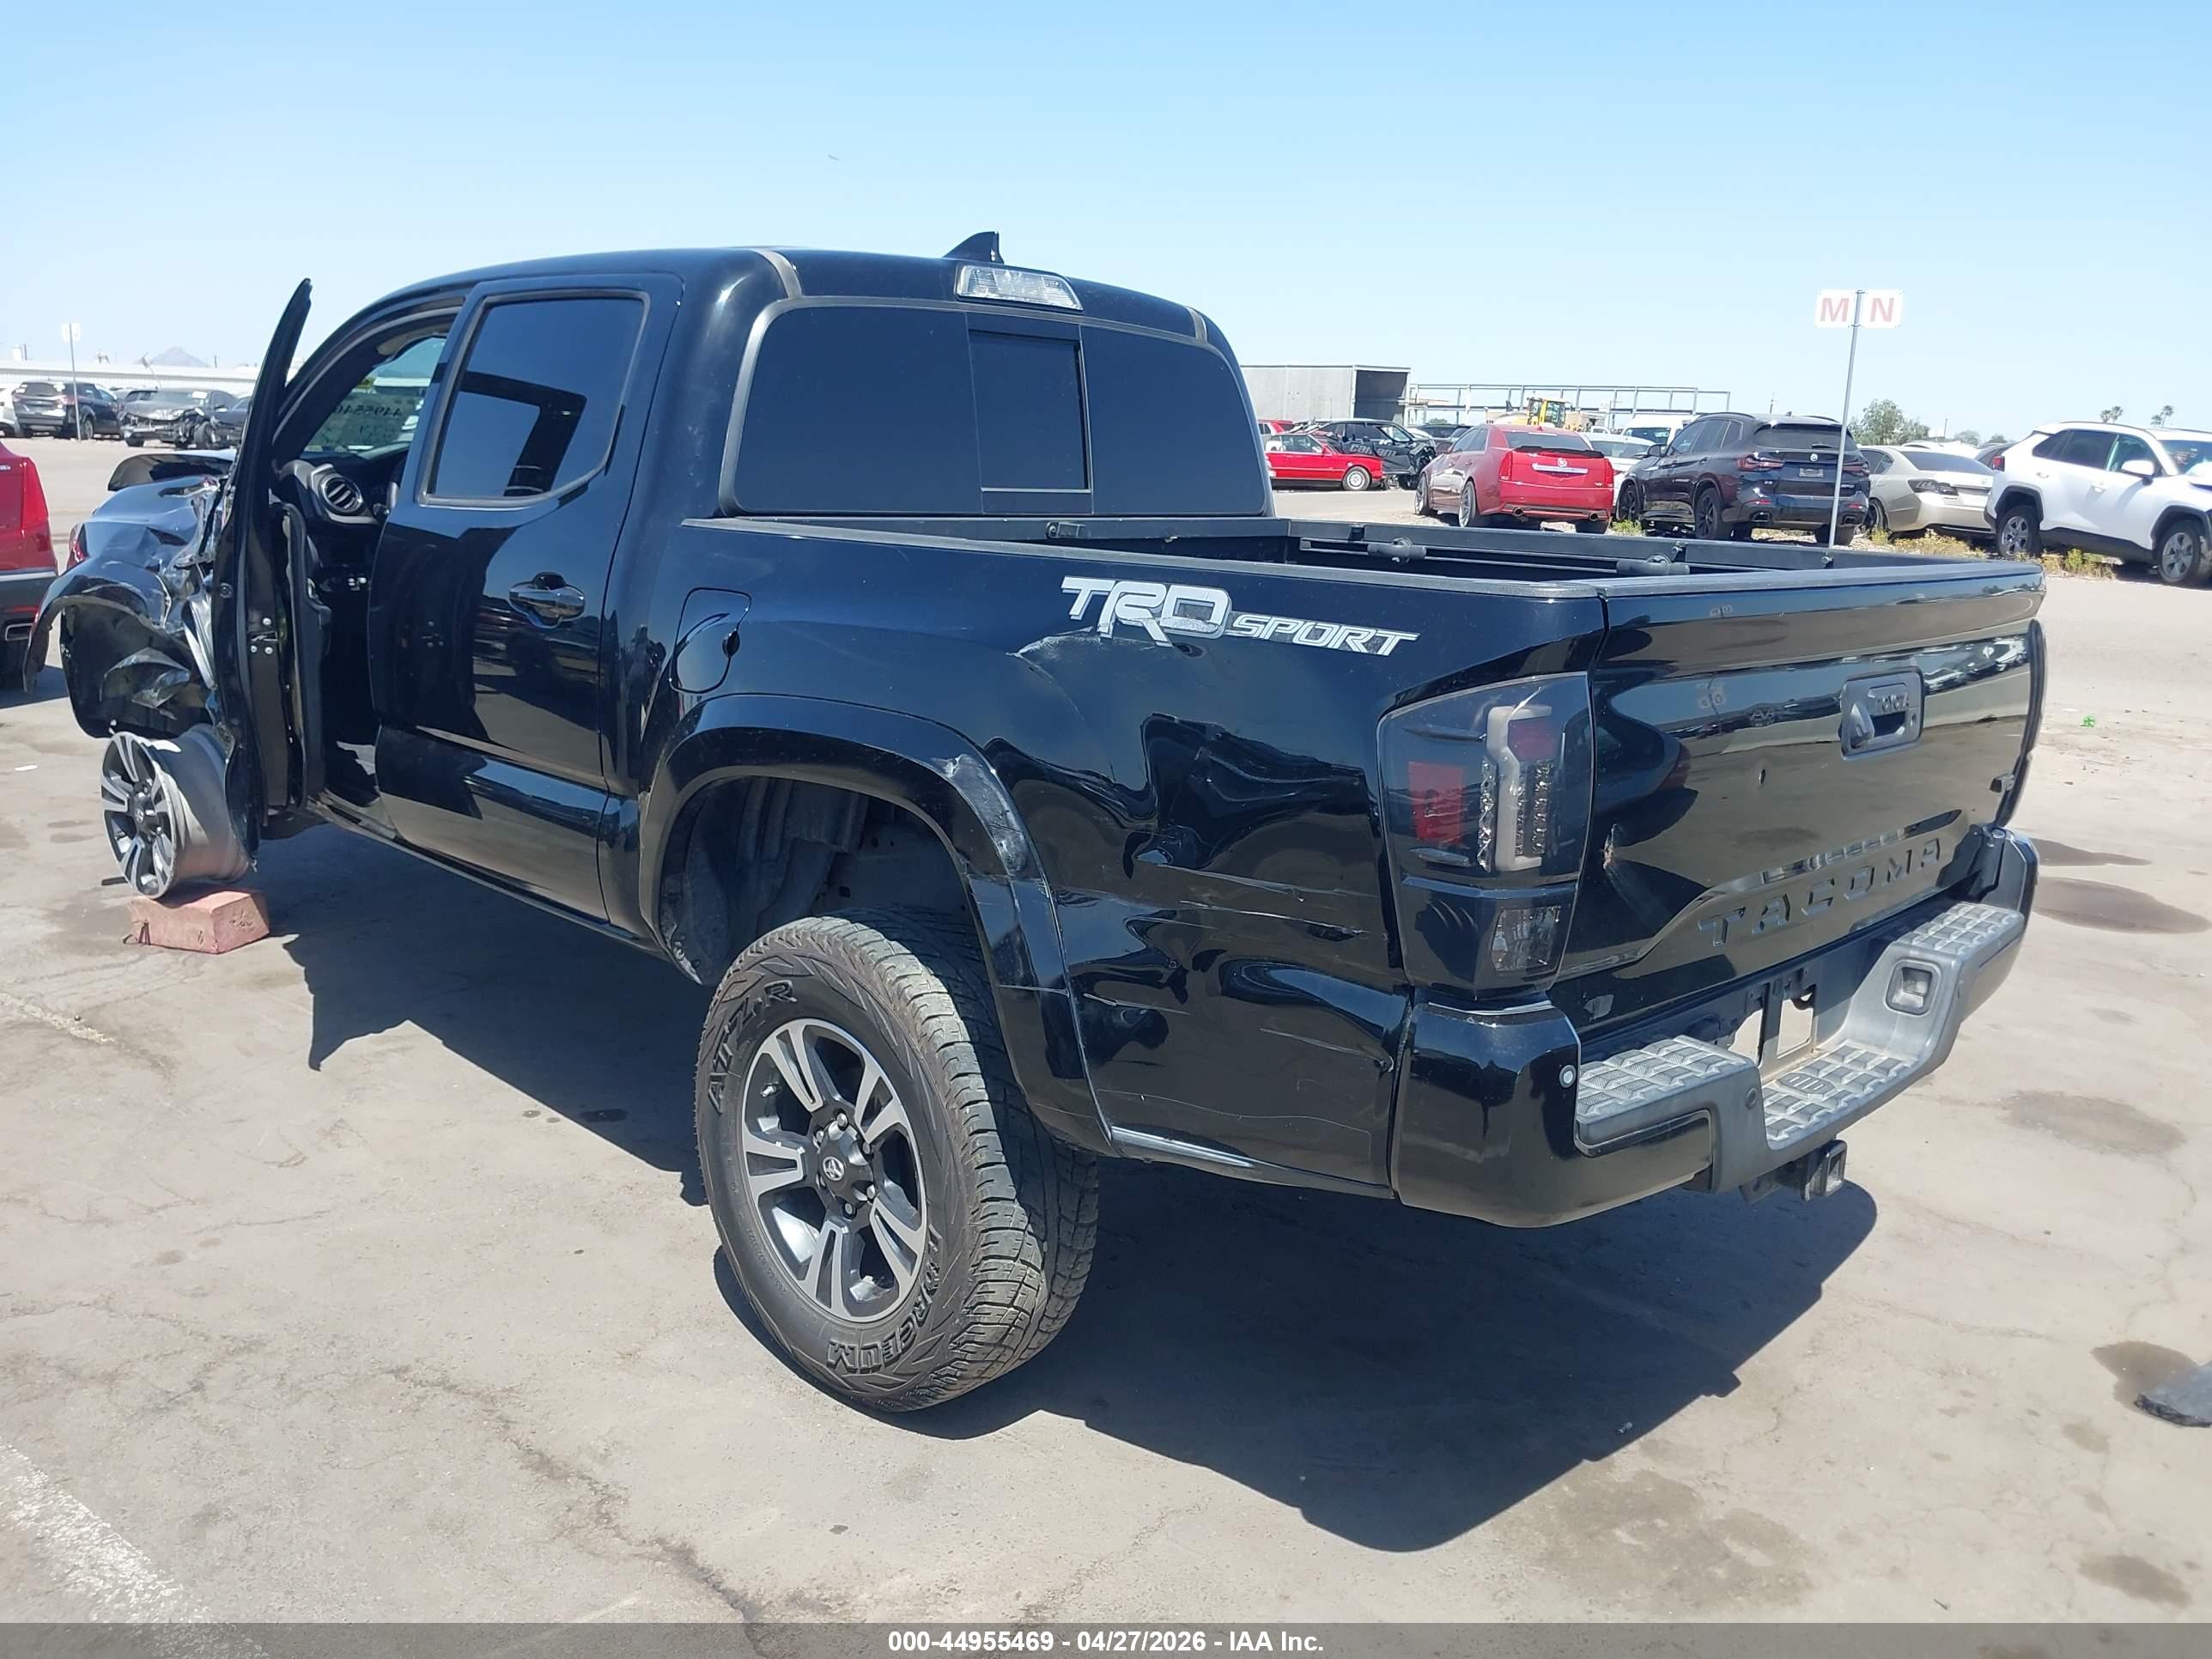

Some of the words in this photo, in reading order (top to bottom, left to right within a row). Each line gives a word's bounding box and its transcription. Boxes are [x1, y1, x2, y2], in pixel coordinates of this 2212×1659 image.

[1820, 298, 1850, 322] M
[1870, 298, 1894, 322] N
[1060, 576, 1231, 647] TRD
[1231, 613, 1421, 656] SPORT
[1697, 837, 1941, 946] TACOMA
